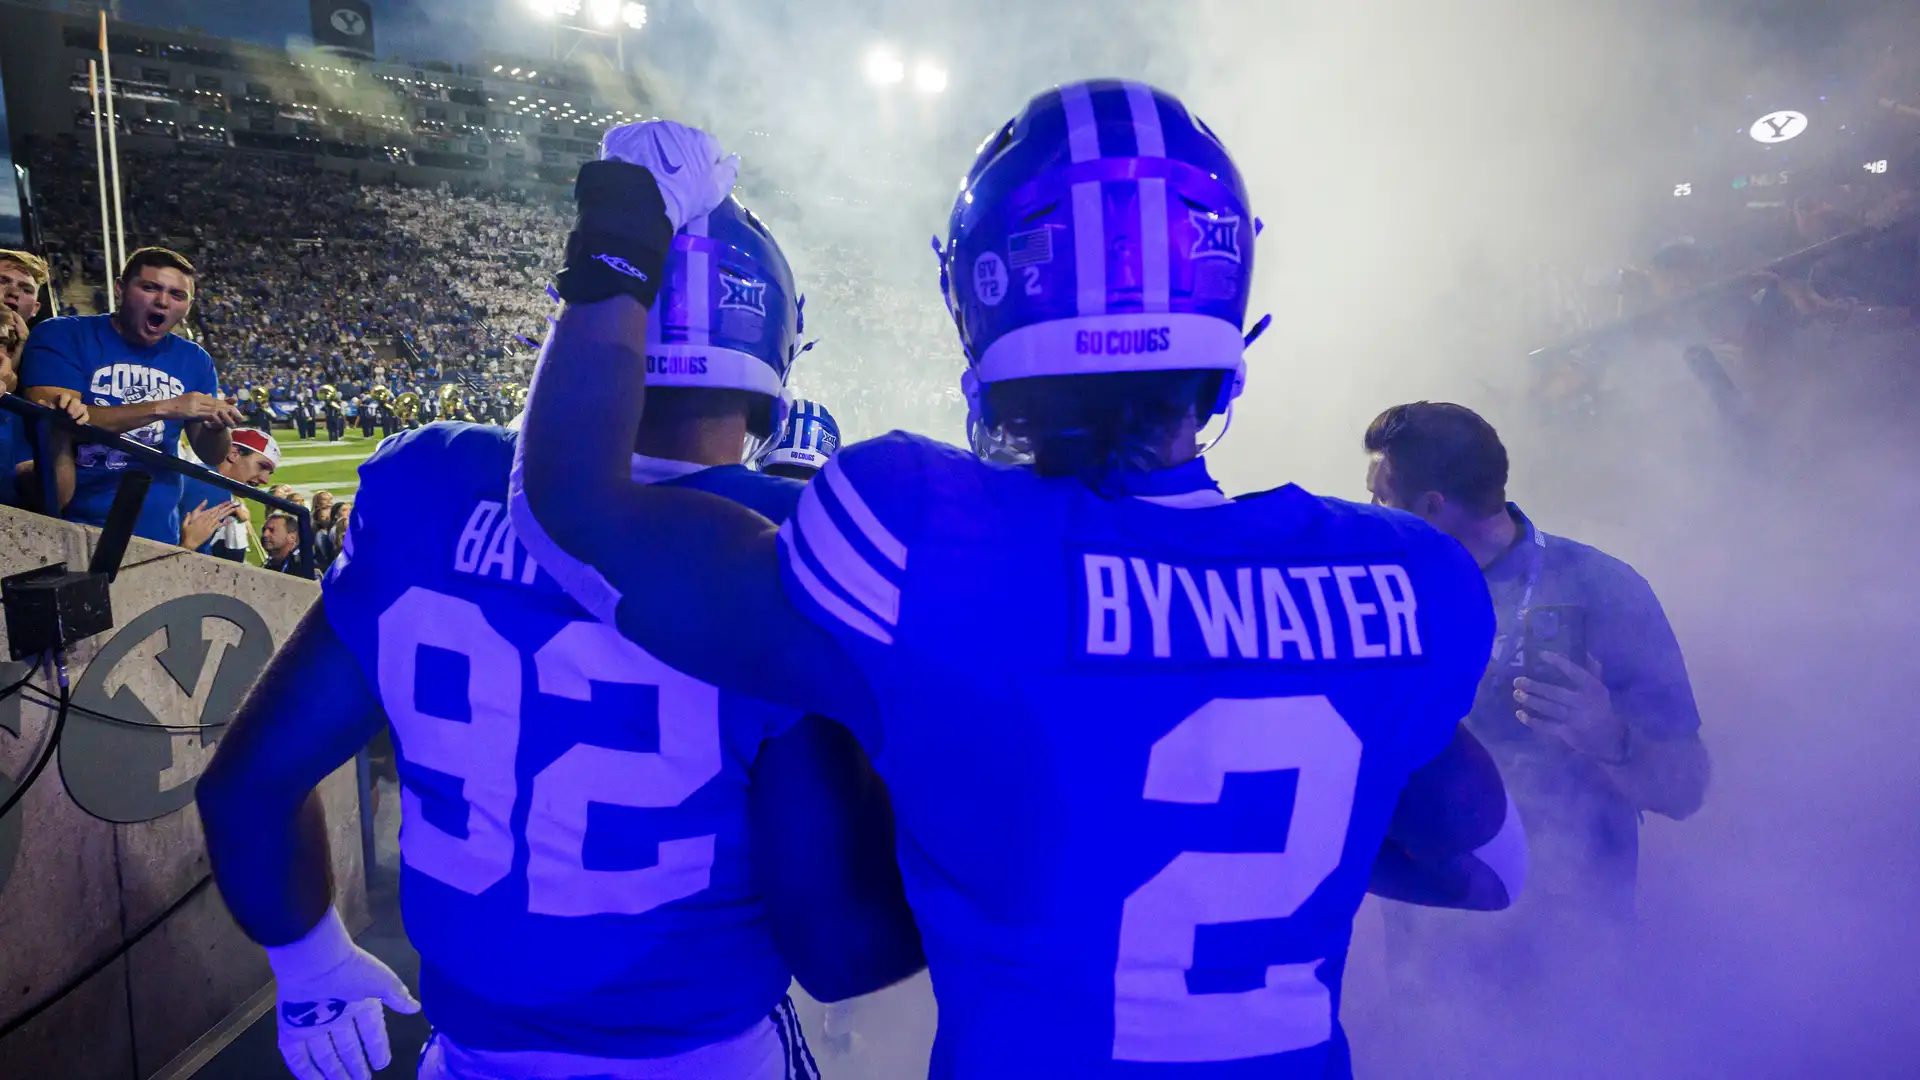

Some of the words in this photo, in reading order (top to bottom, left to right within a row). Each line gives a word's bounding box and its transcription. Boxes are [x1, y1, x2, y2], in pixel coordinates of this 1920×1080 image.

[1763, 116, 1797, 138] Y
[1673, 183, 1691, 197] 25
[722, 279, 765, 314] XII
[1023, 265, 1043, 297] 2
[1076, 329, 1103, 355] GO
[1105, 326, 1170, 355] COUGS
[657, 355, 708, 375] COUGS
[1084, 554, 1422, 661] BYWATER
[378, 585, 723, 917] 92
[1112, 695, 1363, 1062] 2
